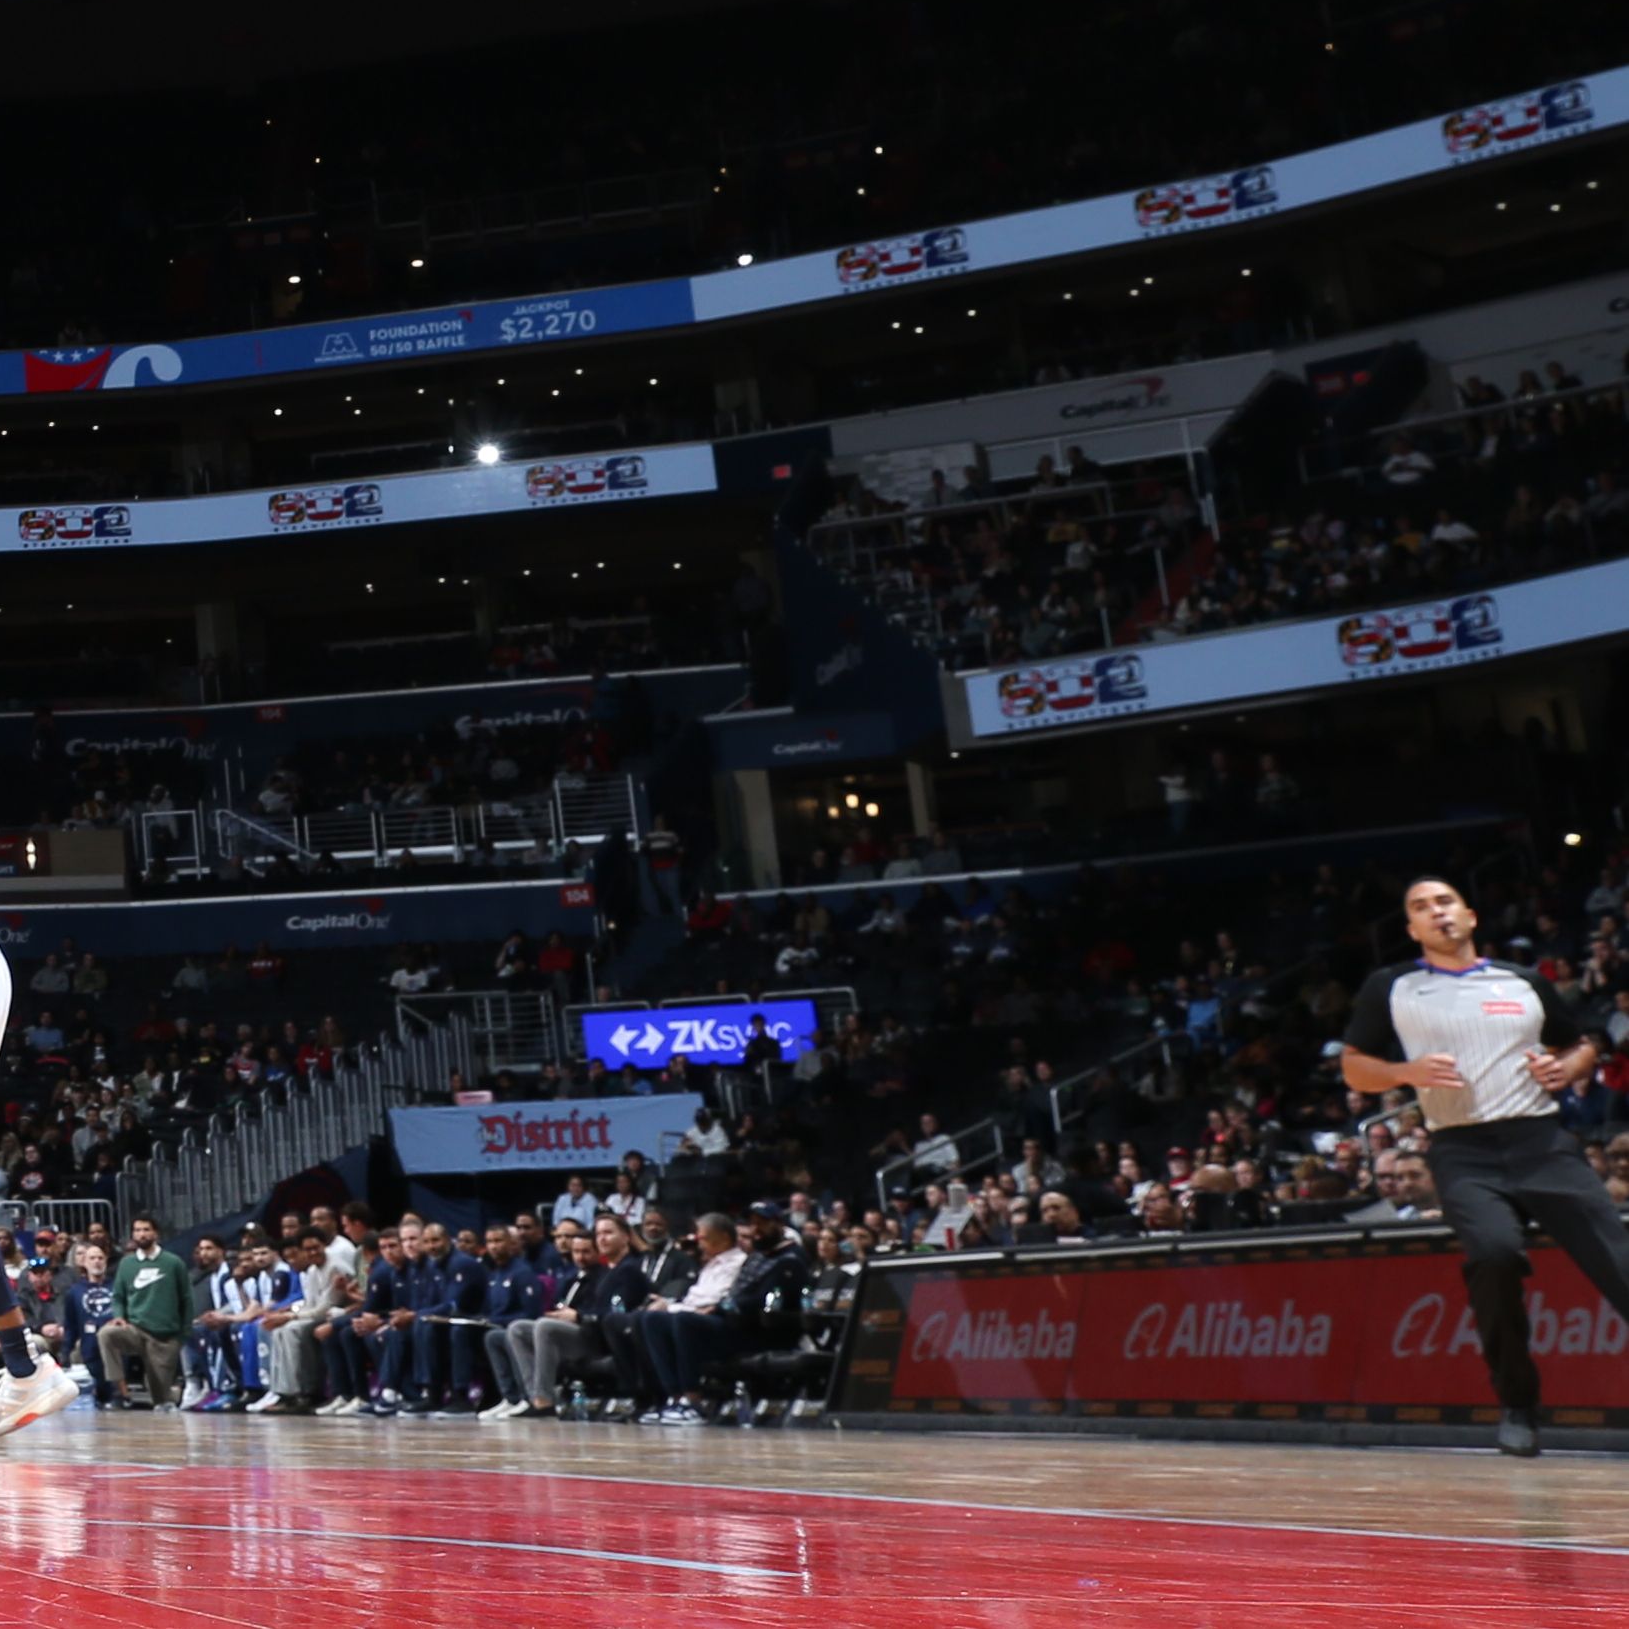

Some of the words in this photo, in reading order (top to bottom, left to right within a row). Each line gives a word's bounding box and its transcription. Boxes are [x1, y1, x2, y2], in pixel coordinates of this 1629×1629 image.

[513, 299, 571, 315] JACKPOT
[370, 320, 463, 341] FOUNDATION
[499, 310, 596, 343] $2,270
[370, 342, 412, 356] 50/50
[416, 334, 465, 352] RAFFLE
[479, 1109, 614, 1156] District
[945, 1306, 1077, 1361] Alibaba
[1166, 1299, 1333, 1360] Alibaba
